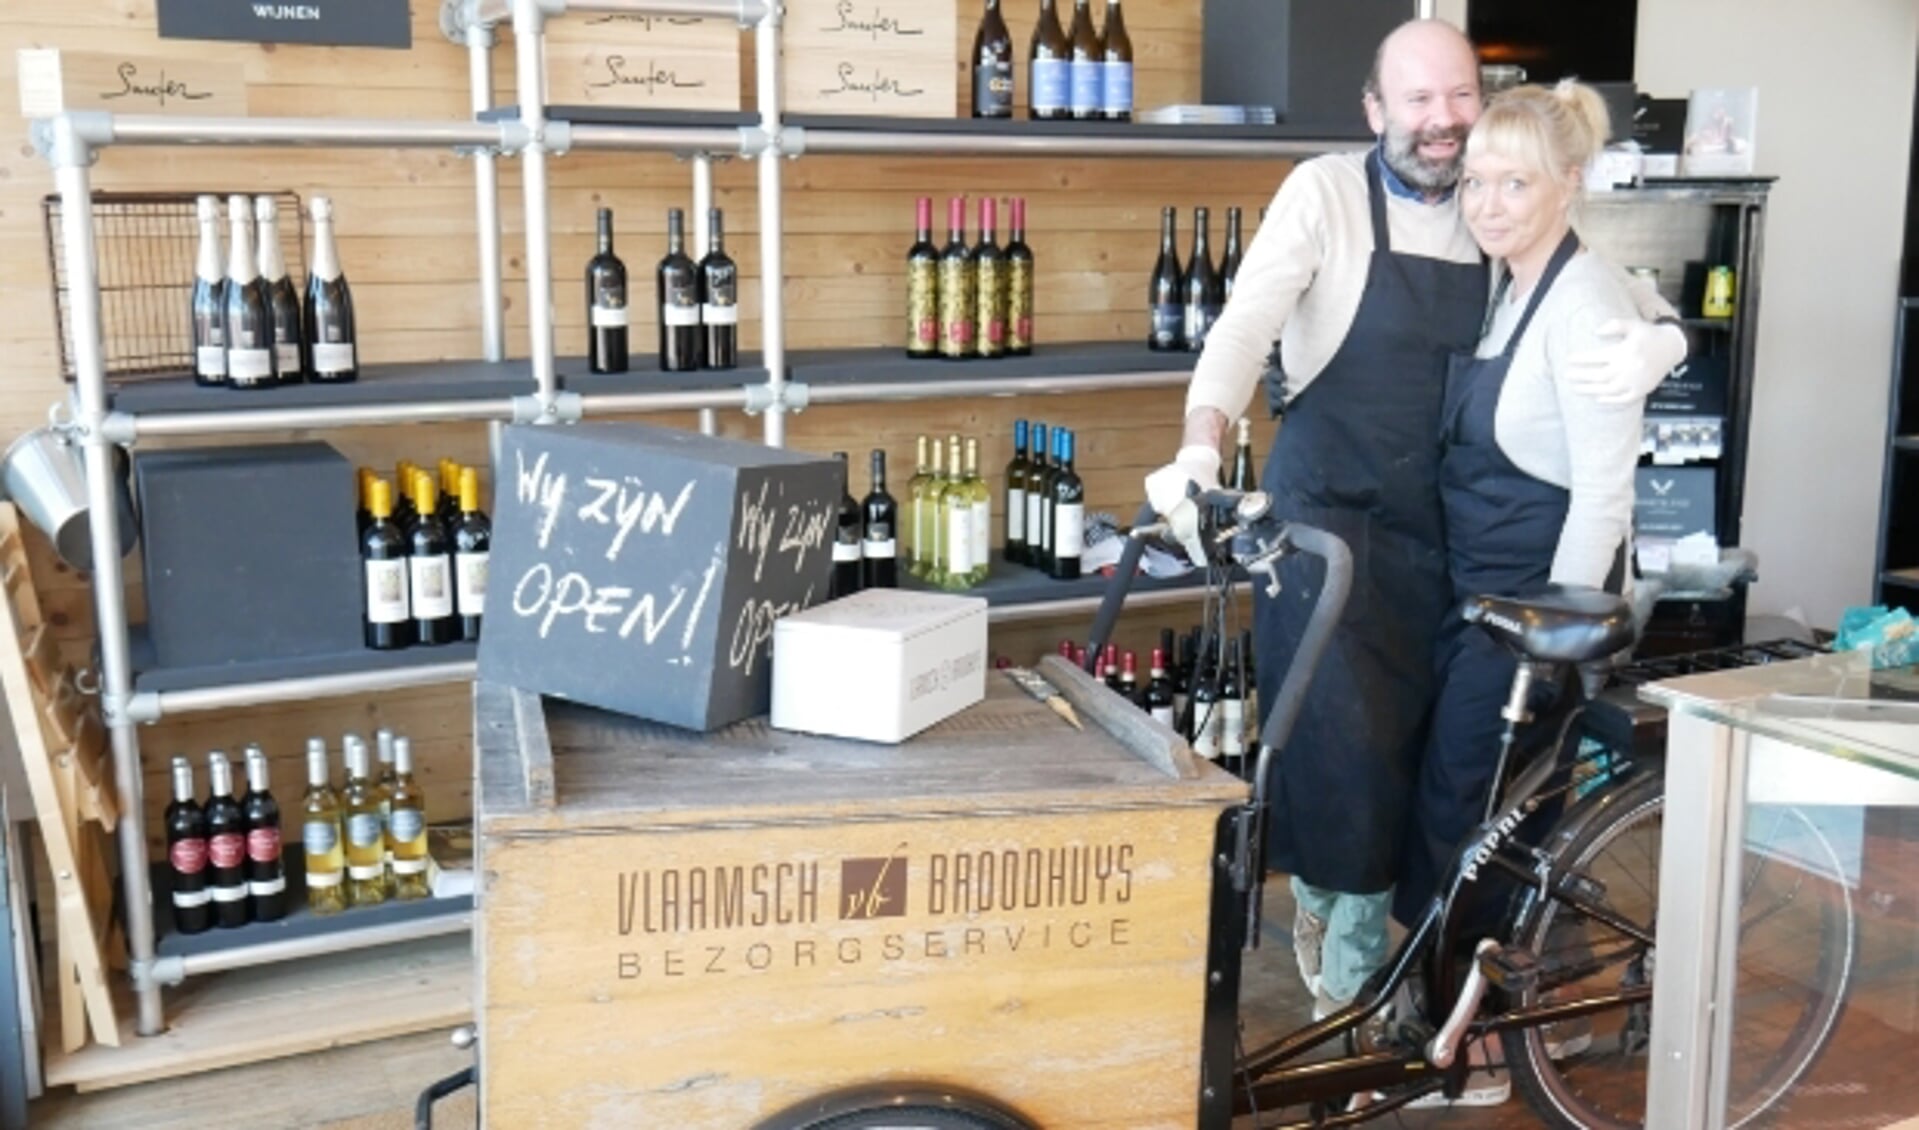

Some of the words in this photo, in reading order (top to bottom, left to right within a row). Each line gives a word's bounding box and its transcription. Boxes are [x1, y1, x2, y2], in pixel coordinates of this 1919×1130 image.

[252, 3, 321, 20] WIJNEN
[512, 545, 724, 668] OPEN!
[1461, 806, 1528, 882] POPAL
[617, 860, 820, 937] VLAAMSCH
[928, 843, 1135, 915] BROODHUYS
[616, 917, 1133, 980] BEZORGSERVICE
